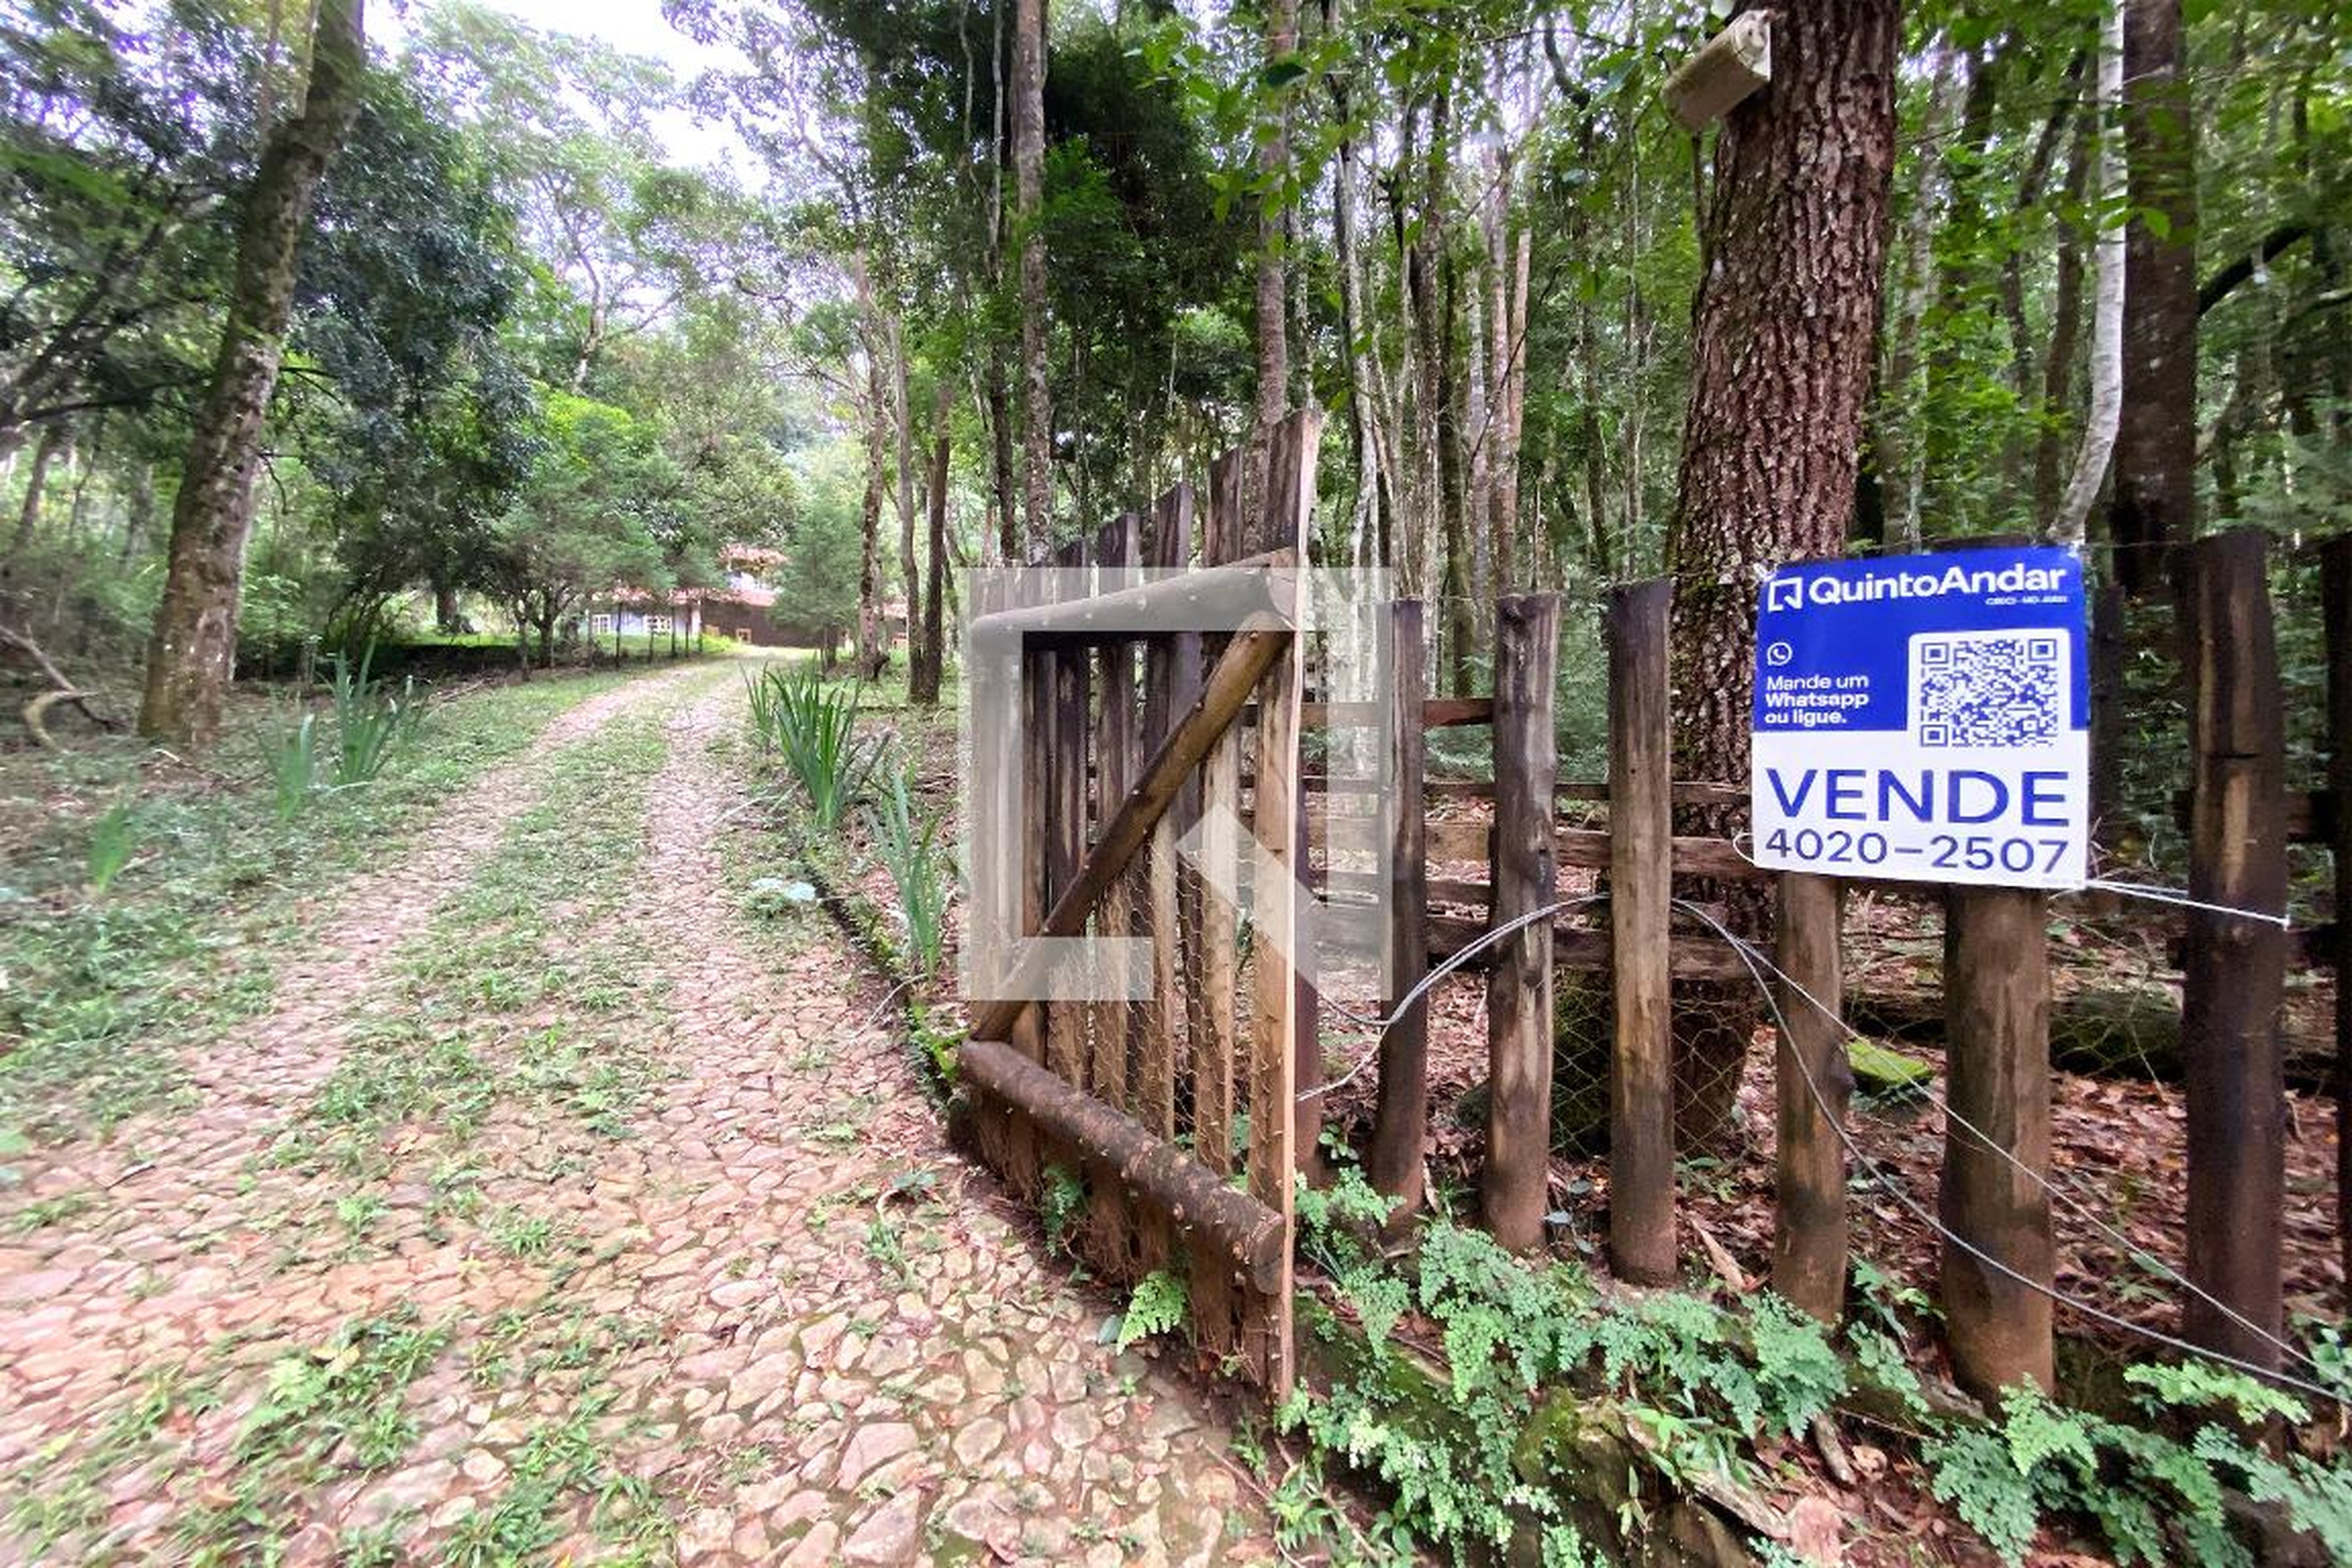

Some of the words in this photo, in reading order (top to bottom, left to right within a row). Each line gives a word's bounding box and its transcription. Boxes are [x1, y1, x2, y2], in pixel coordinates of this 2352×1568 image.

[1809, 564, 2066, 605] QuintoAndar
[1766, 676, 1831, 690] Mande
[1836, 676, 1869, 688] um
[1765, 693, 1869, 709] Whatsapp
[1765, 710, 1789, 723] ou
[1793, 709, 1847, 727] ligue.
[1766, 768, 2070, 827] VENDE
[1766, 829, 2068, 875] 4020-2507
